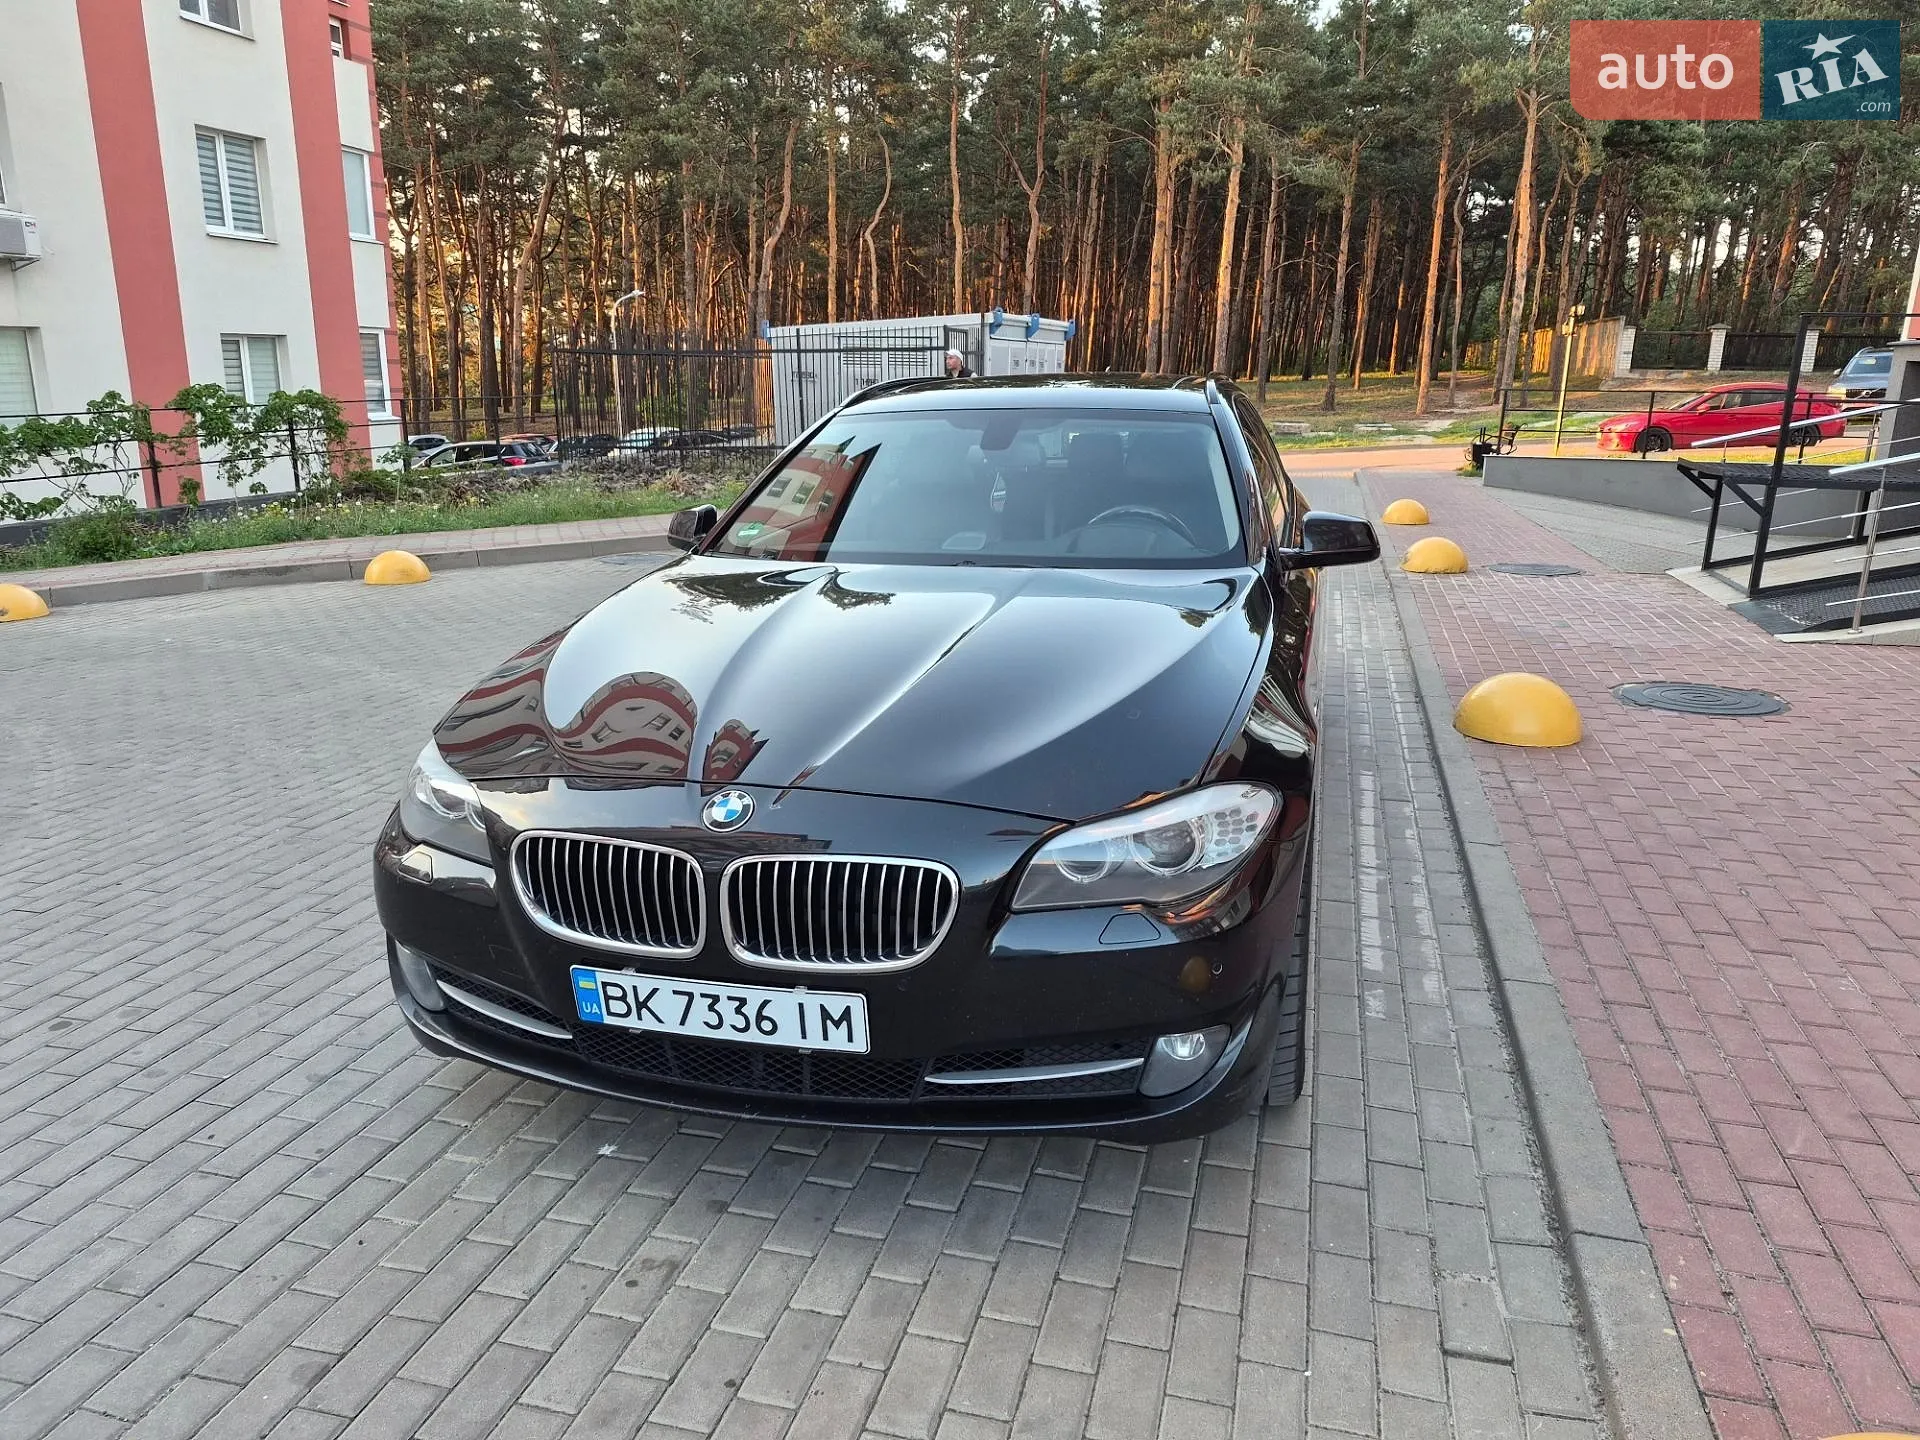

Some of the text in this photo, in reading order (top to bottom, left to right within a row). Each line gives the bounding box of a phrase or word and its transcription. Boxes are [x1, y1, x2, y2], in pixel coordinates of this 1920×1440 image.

[582, 1001, 600, 1015] UA
[600, 981, 854, 1043] BK 7336 IM
